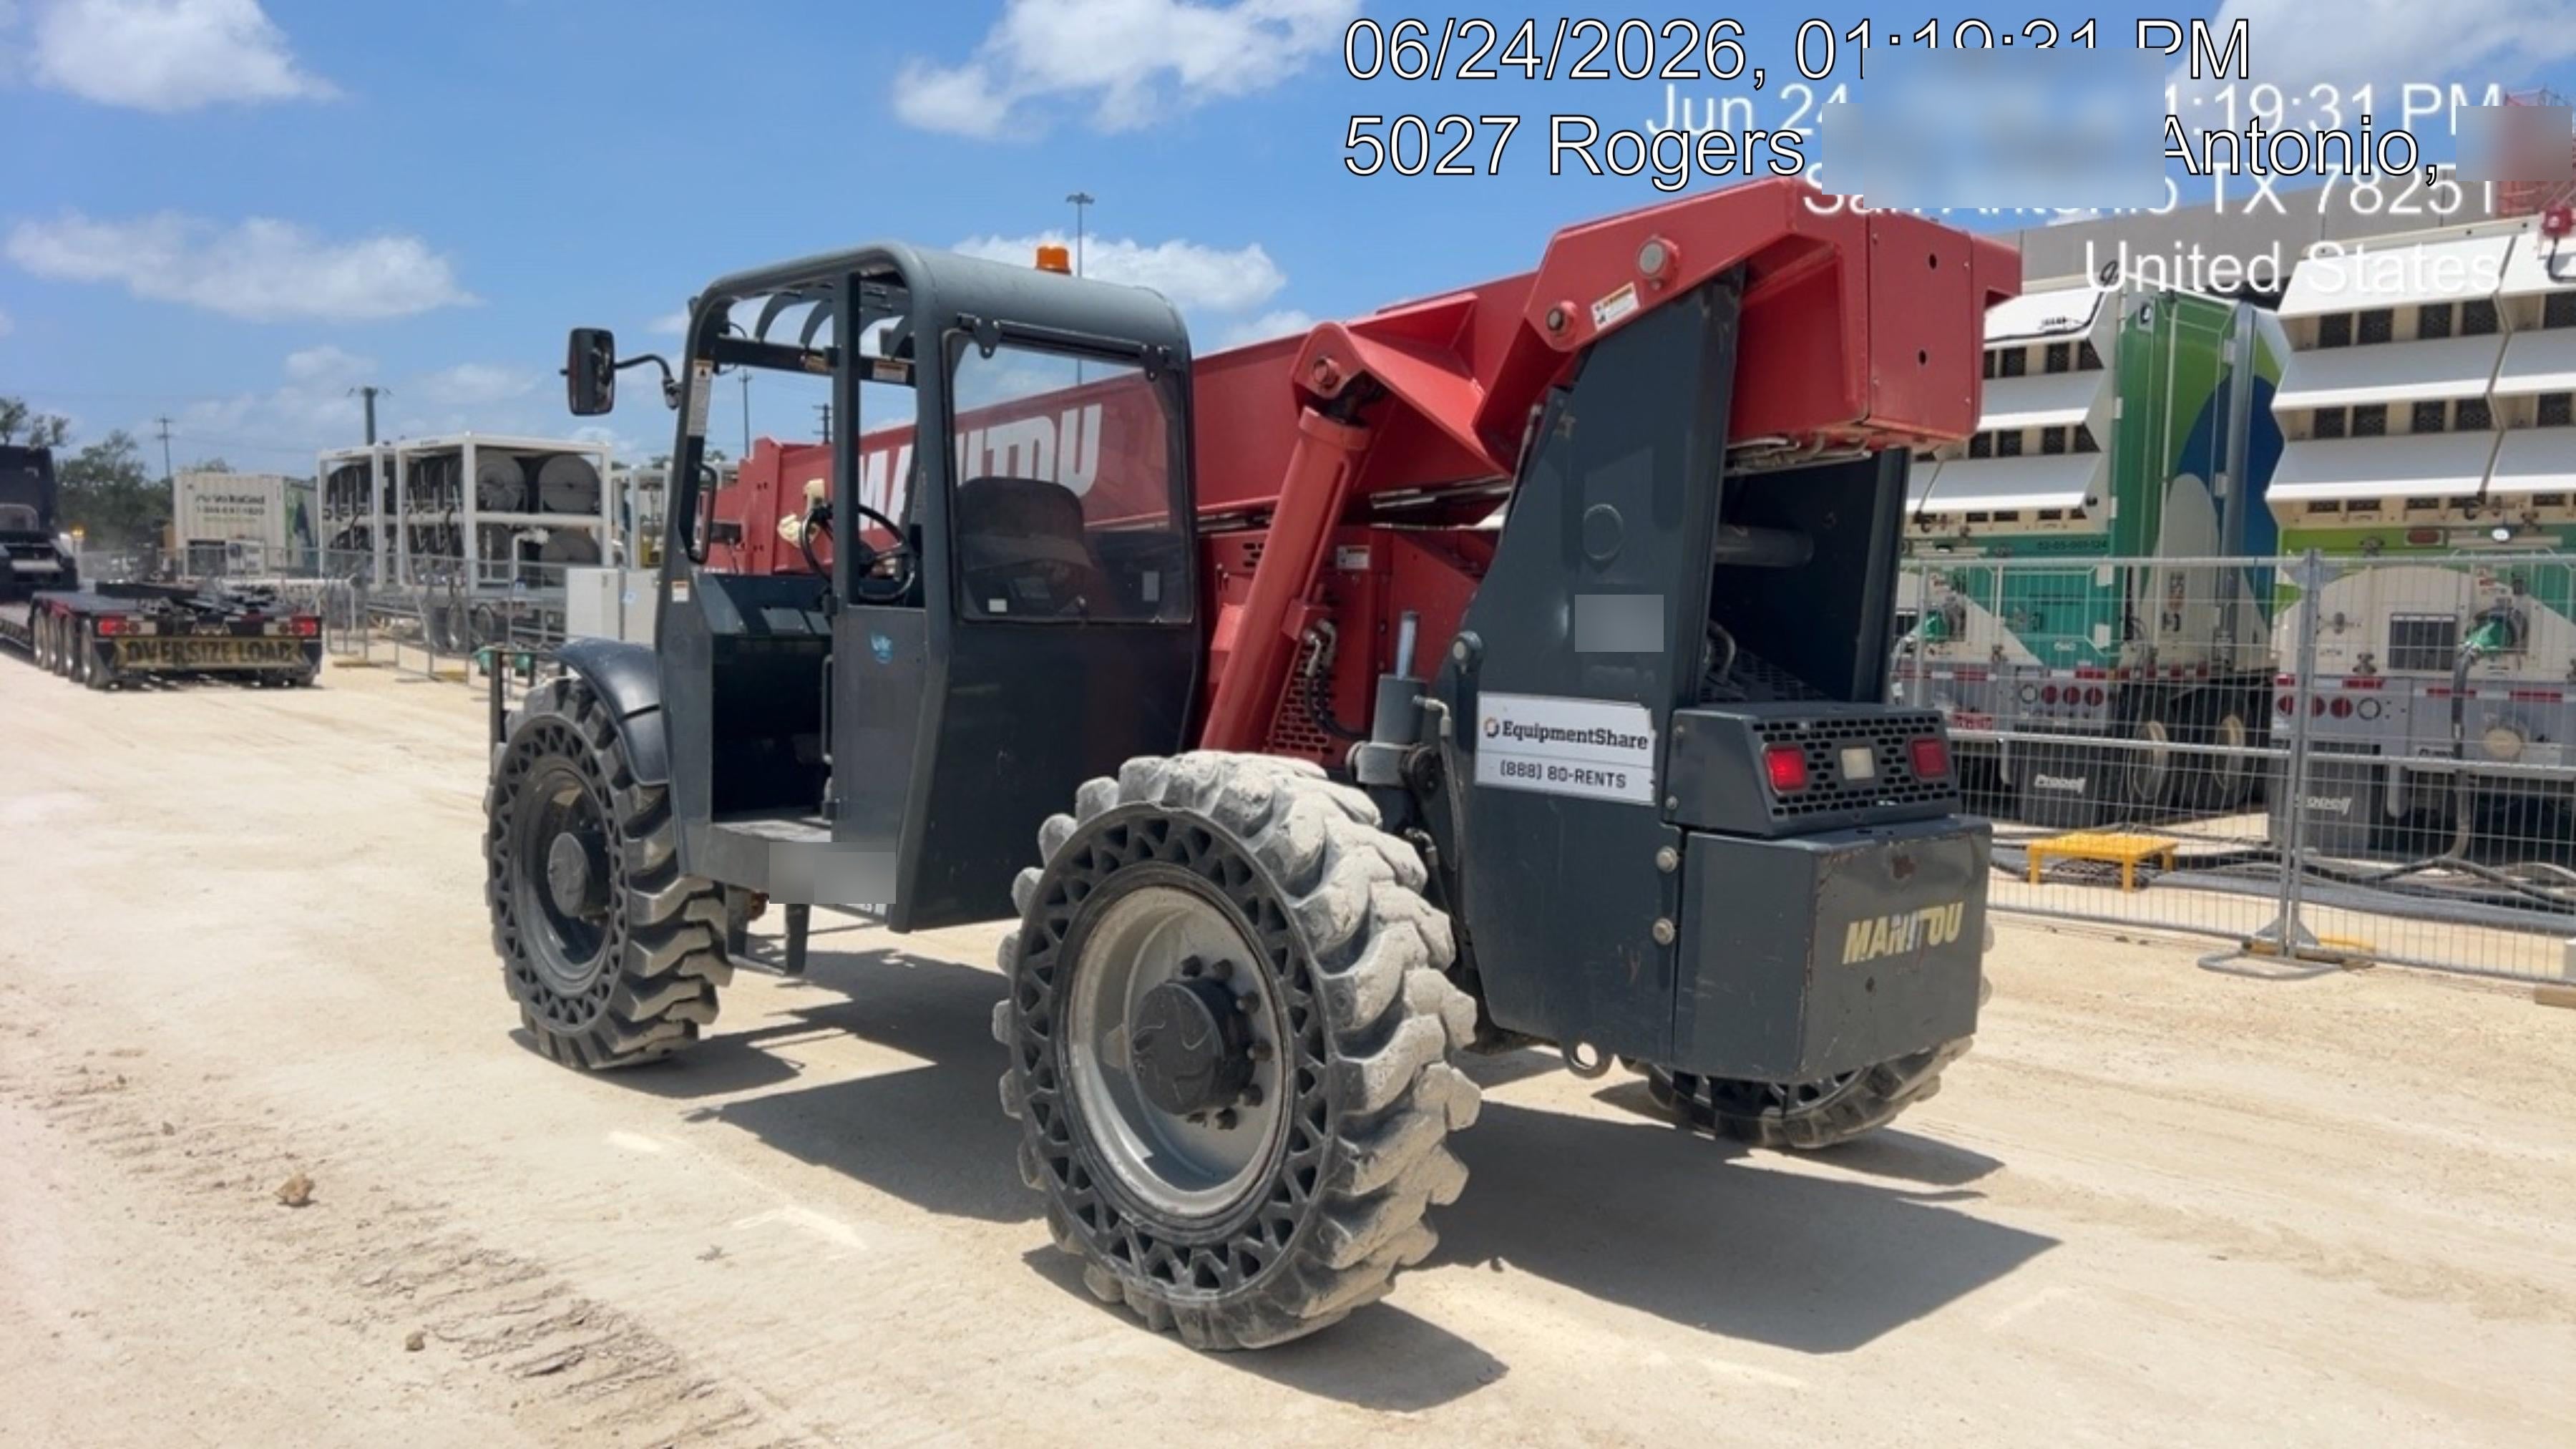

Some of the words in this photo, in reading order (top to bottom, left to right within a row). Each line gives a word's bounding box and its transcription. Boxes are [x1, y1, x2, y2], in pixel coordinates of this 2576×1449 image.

[126, 639, 233, 663] OVERSIZE
[237, 639, 293, 663] LOAD
[1503, 720, 1649, 750] EquipmentShare
[1547, 765, 1627, 788] 80-RENTS
[1841, 901, 1964, 965] MANITOU
